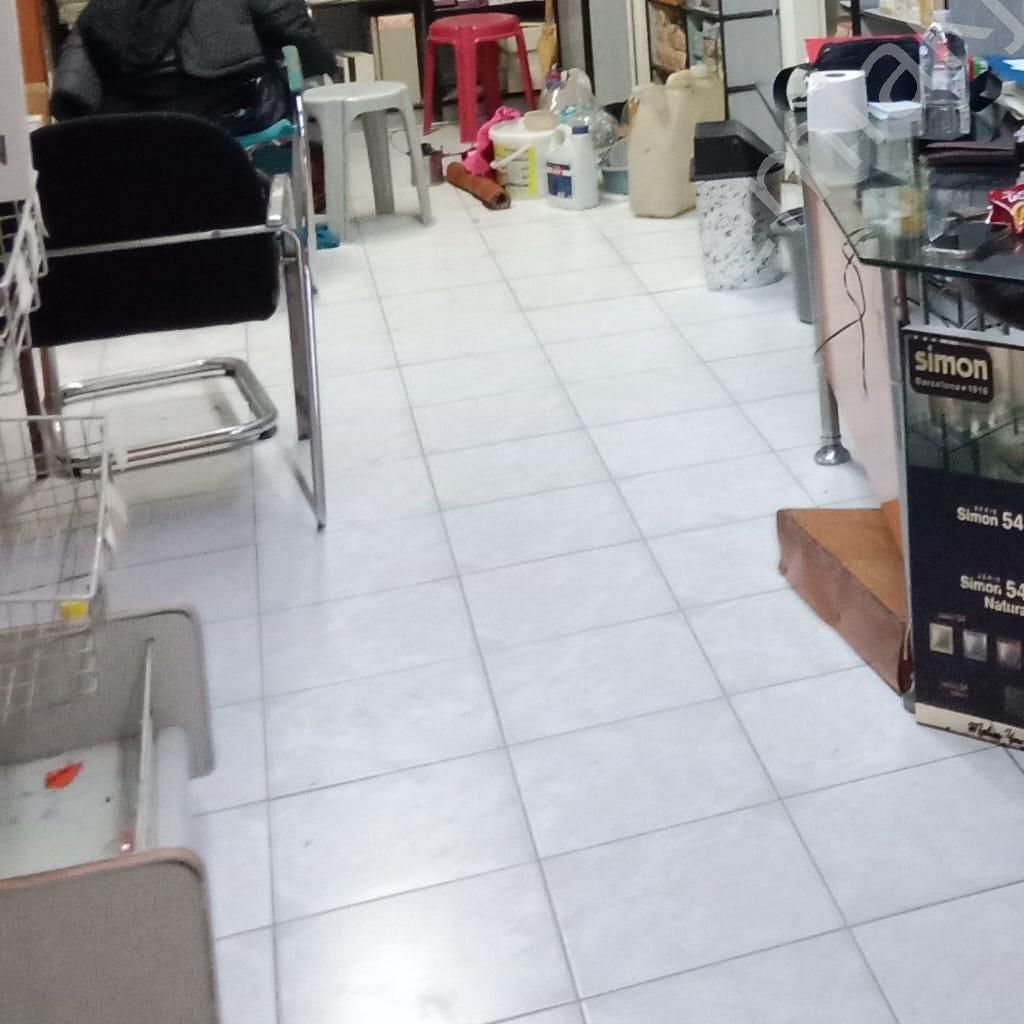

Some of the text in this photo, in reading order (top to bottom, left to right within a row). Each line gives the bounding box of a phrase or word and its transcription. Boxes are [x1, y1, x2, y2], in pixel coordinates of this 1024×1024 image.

[915, 344, 988, 381] simon
[956, 506, 999, 527] Simon
[1001, 511, 1024, 531] 54
[960, 575, 1003, 596] Simon
